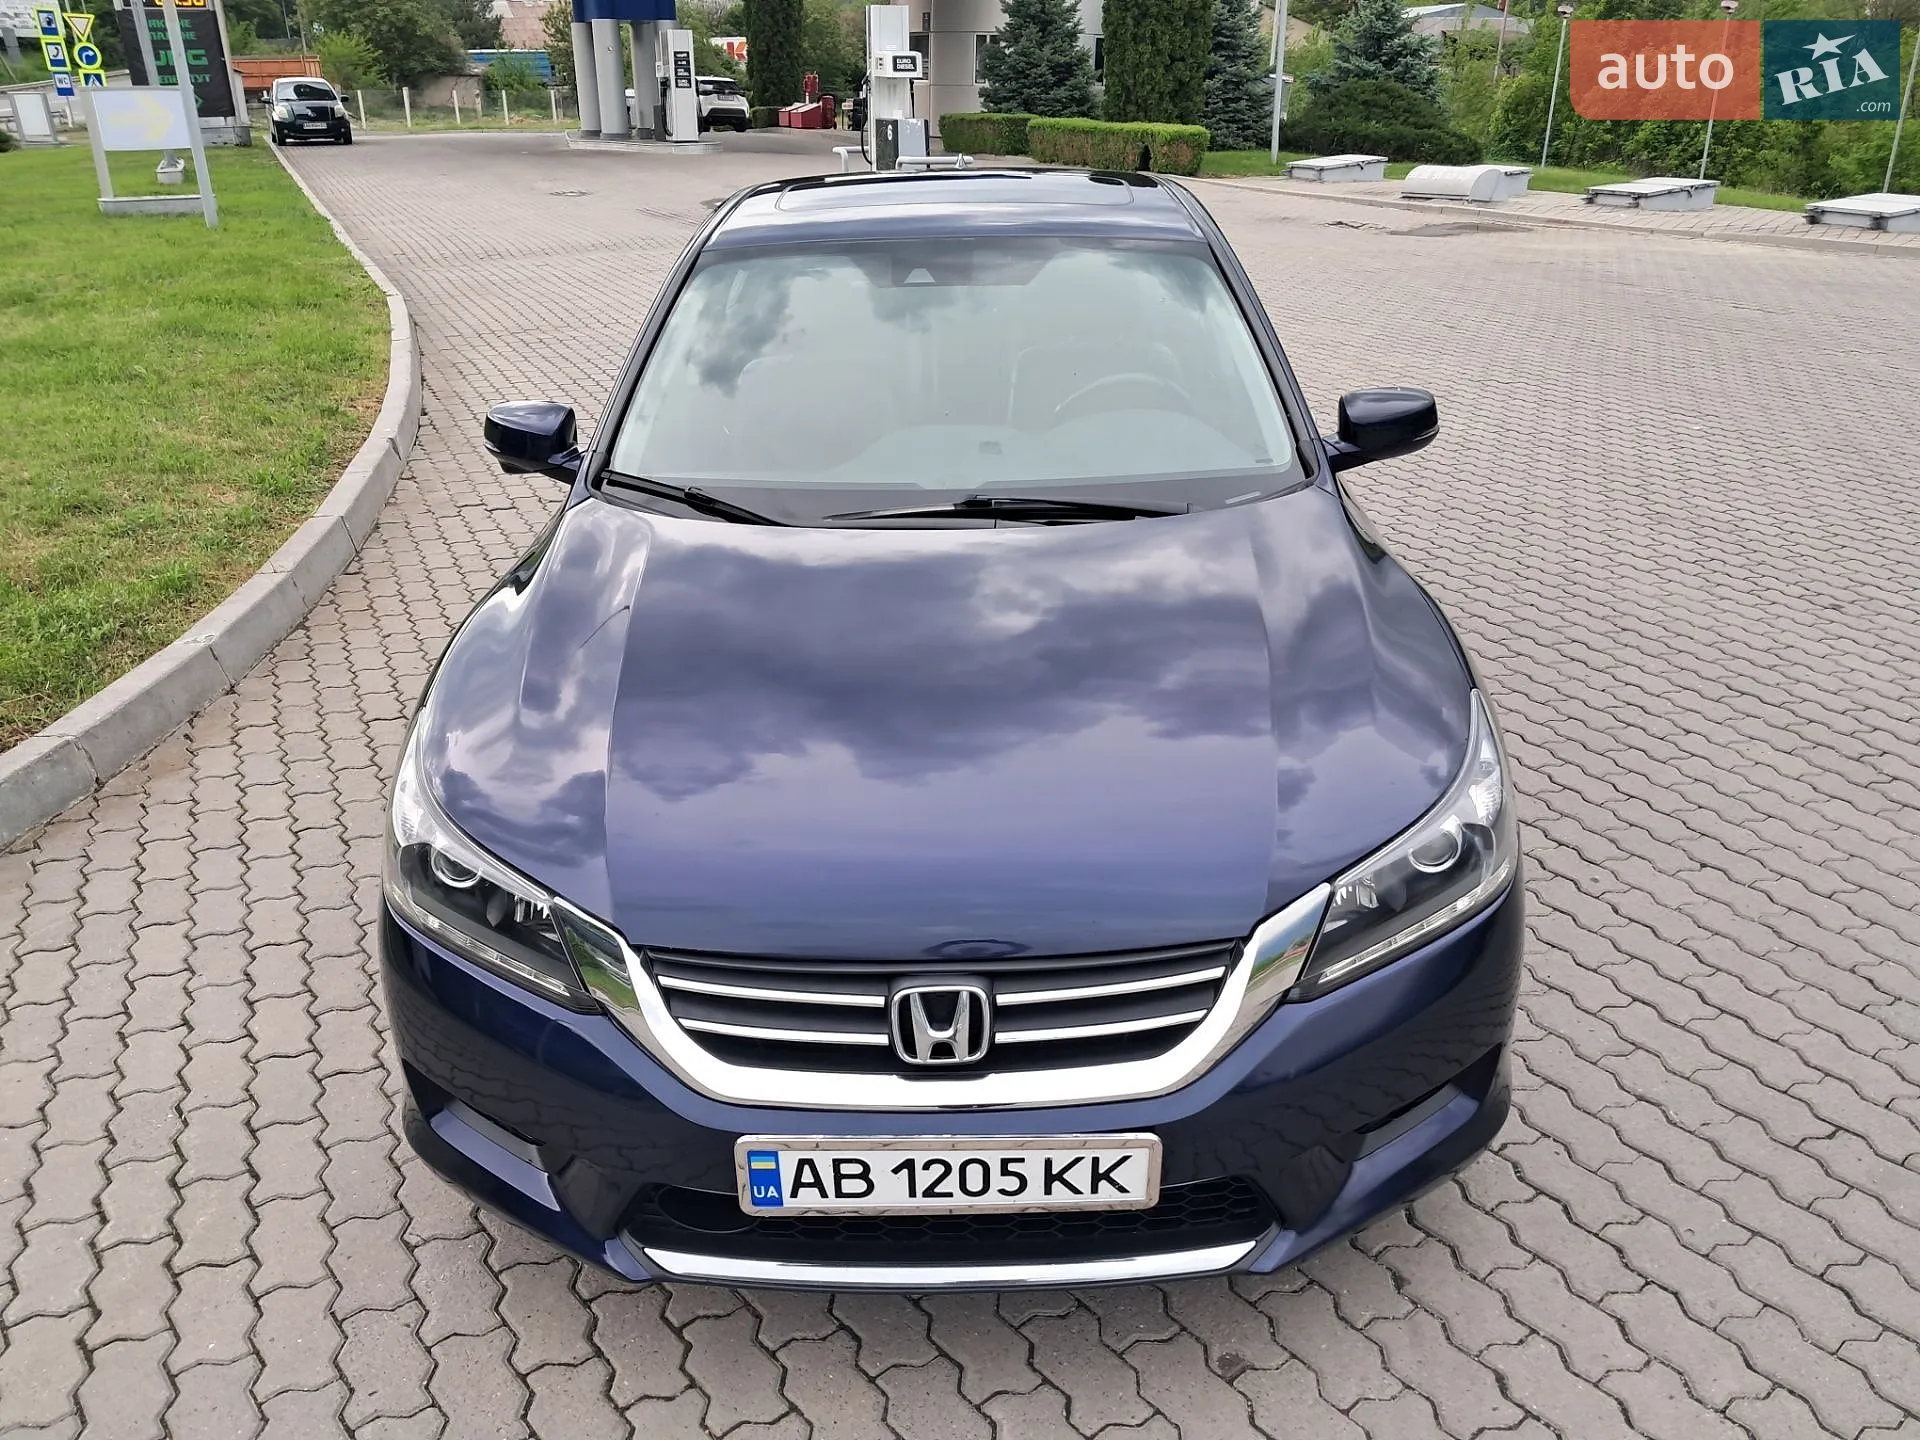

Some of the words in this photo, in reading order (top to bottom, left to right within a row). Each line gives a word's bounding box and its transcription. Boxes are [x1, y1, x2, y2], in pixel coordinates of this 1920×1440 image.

[887, 124, 893, 141] 6
[789, 1157, 875, 1199] AB
[891, 1157, 1028, 1199] 1205
[1043, 1155, 1134, 1196] KK
[753, 1186, 780, 1199] UA
